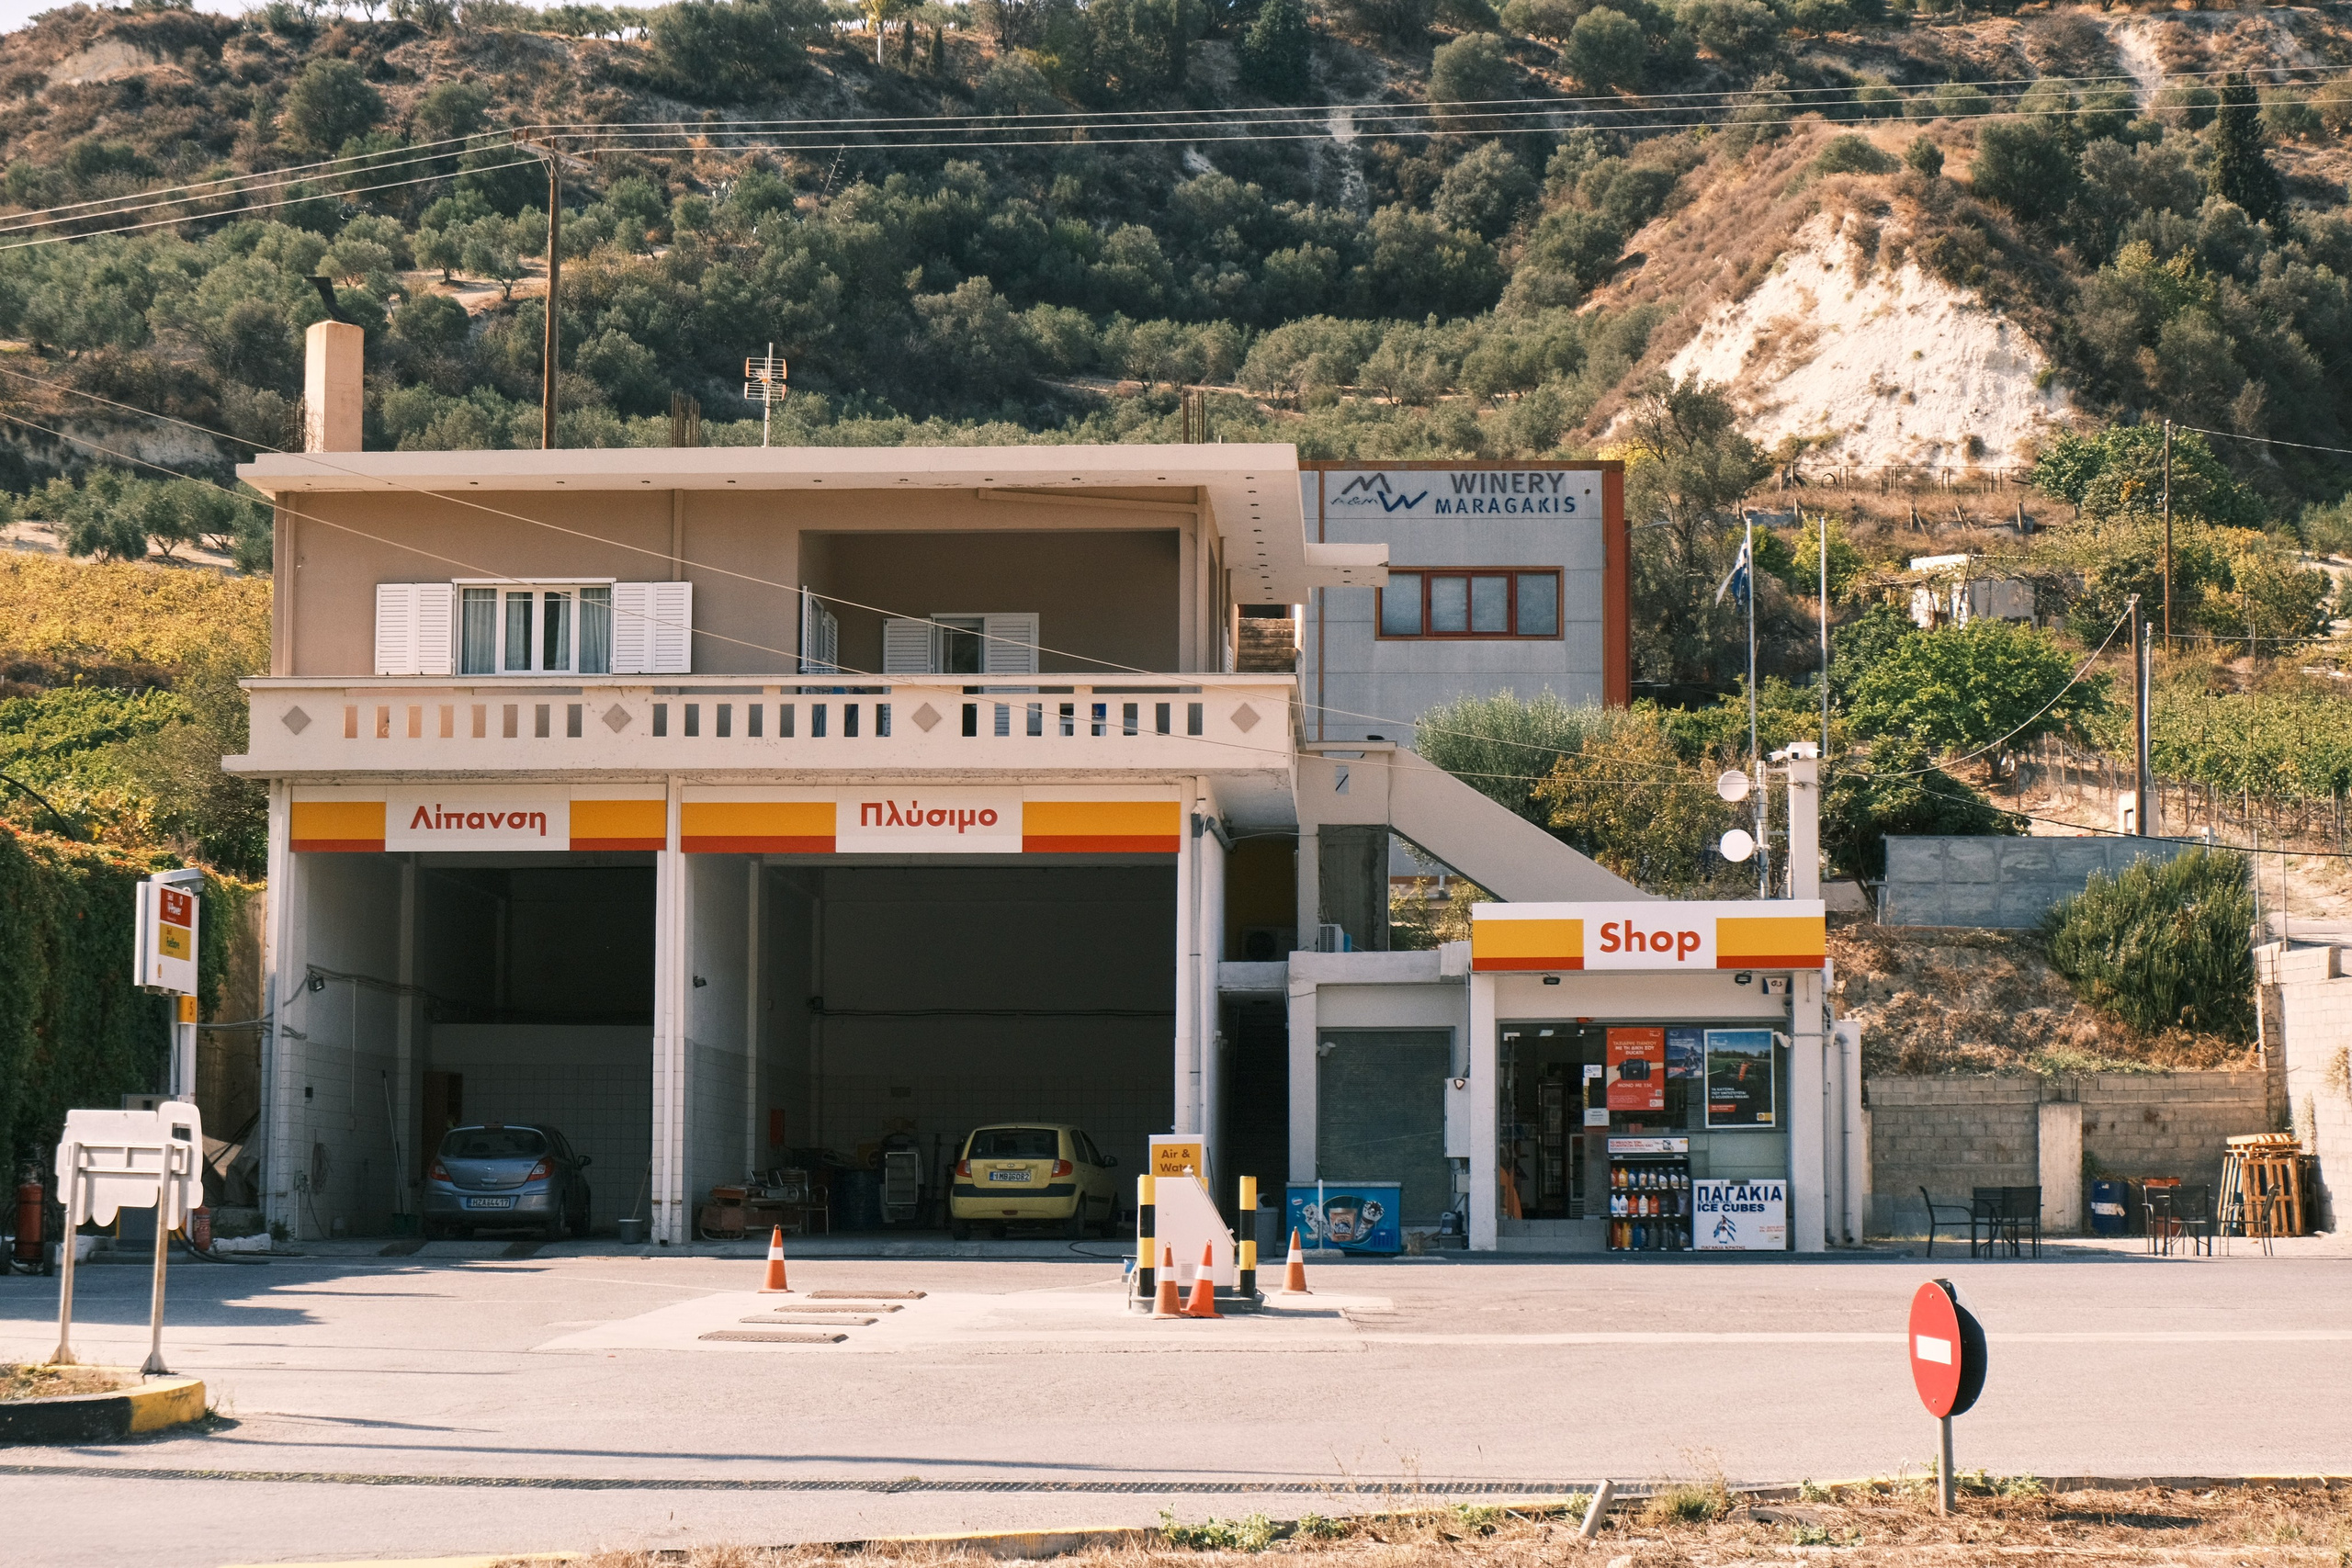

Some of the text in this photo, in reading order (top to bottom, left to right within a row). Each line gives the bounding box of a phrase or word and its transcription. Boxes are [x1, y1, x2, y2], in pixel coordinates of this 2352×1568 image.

[1451, 472, 1565, 494] WINERY
[1435, 496, 1576, 514] MARAGAKIS
[410, 804, 547, 836] Λίπανση
[861, 799, 999, 833] Πλύσιμο
[1600, 919, 1702, 962] Shop
[1161, 1149, 1191, 1158] Air &
[1159, 1163, 1194, 1172] Watr
[1697, 1186, 1783, 1201] ΠΑΓΑΚΙΑ
[1697, 1203, 1766, 1213] ICE CUBES
